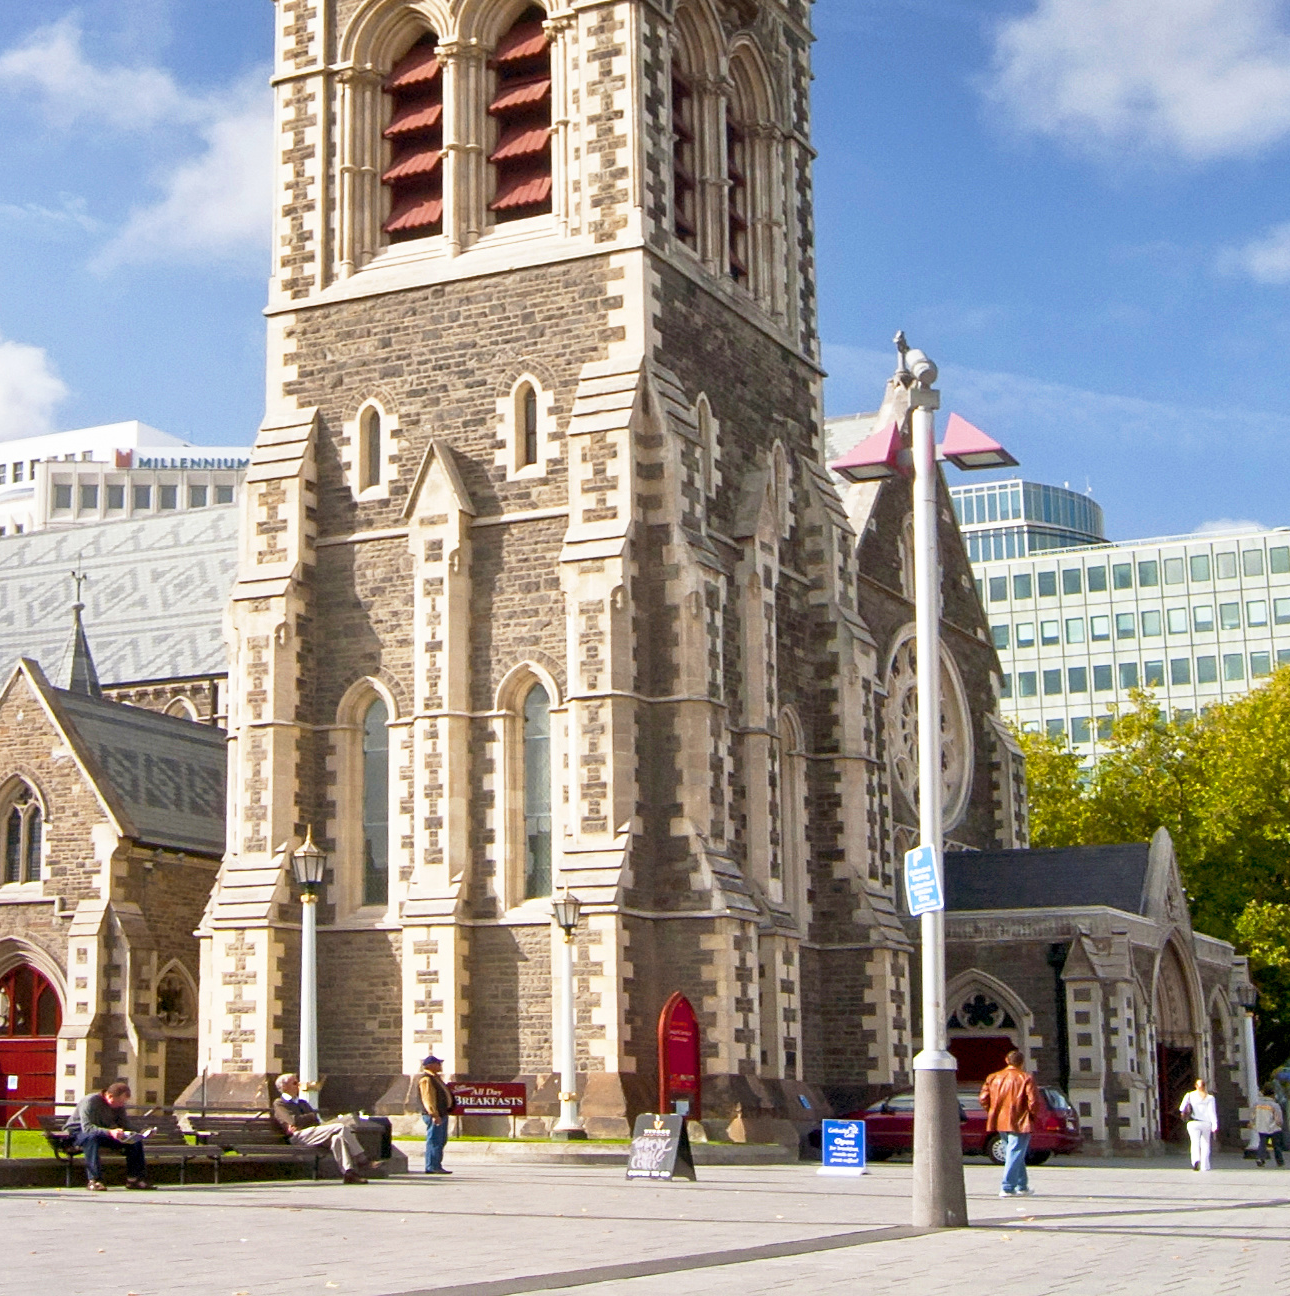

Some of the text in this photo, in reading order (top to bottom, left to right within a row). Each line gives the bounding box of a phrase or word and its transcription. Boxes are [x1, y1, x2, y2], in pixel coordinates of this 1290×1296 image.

[138, 457, 250, 469] MILLENNIUM
[470, 1088, 485, 1096] All
[454, 1095, 524, 1106] BREAKFASTS
